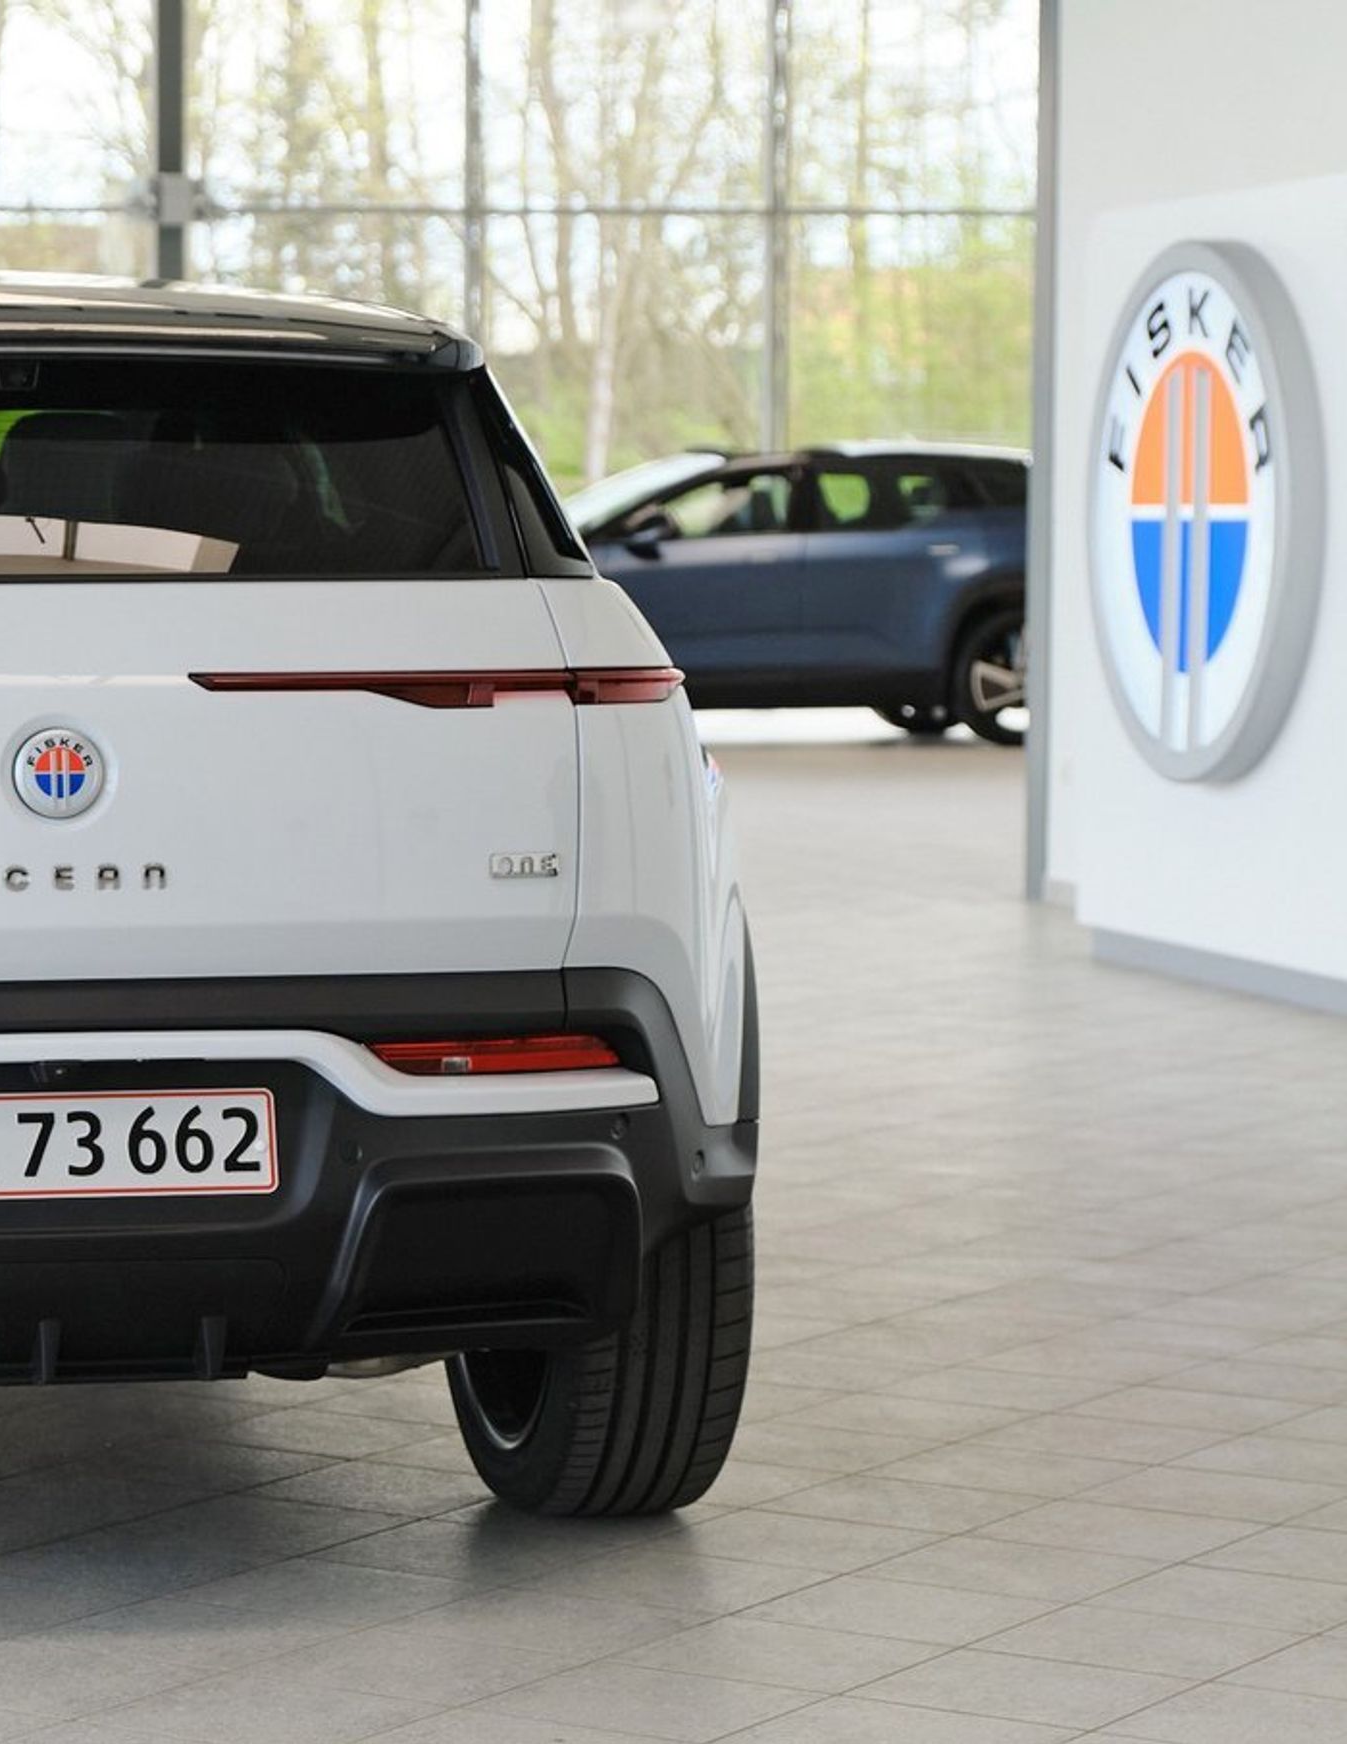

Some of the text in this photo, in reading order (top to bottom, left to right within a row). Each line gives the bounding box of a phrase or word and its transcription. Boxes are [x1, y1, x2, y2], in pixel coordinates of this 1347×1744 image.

[1108, 286, 1271, 474] FISKER
[26, 738, 93, 767] FISKER
[17, 1110, 105, 1178] 73
[127, 1105, 262, 1175] 662
